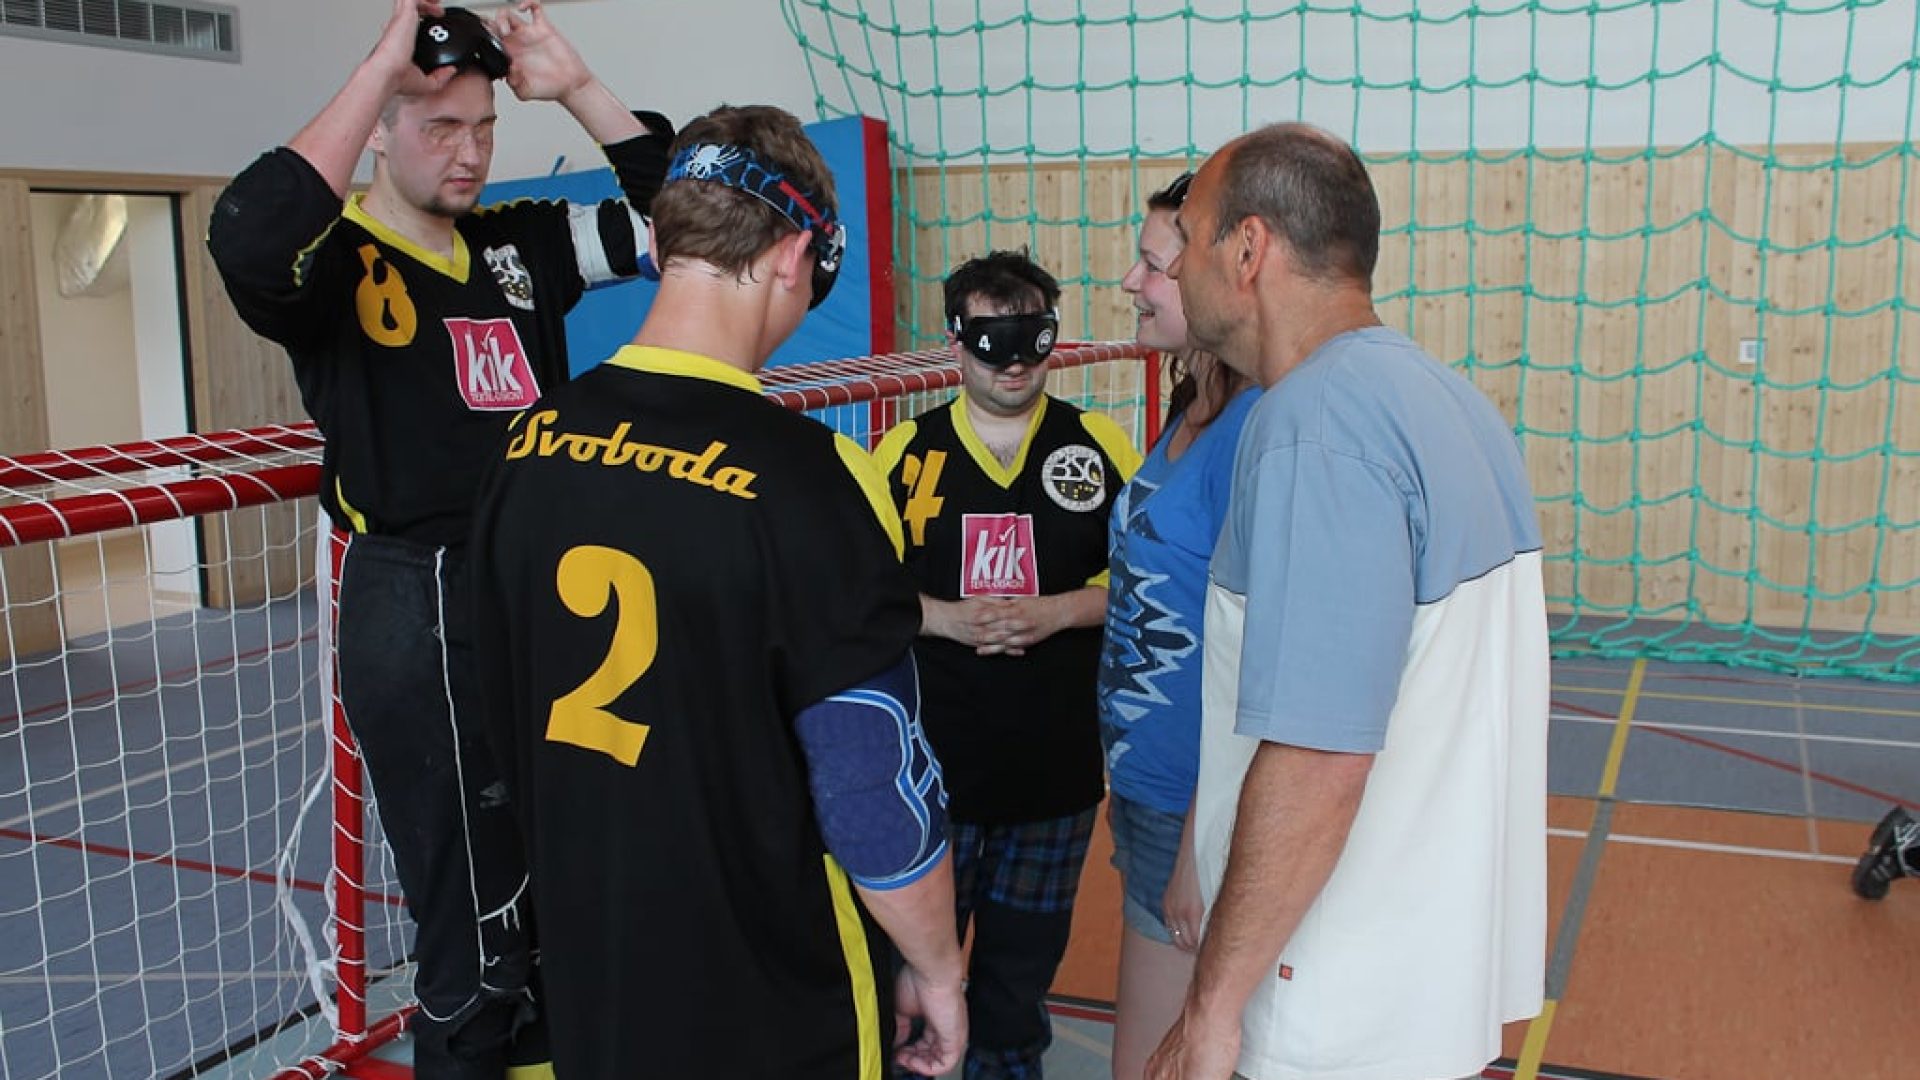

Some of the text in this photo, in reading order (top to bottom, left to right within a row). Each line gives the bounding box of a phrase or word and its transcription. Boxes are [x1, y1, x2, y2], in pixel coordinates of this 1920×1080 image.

[429, 25, 449, 42] 8
[979, 335, 991, 352] 4
[506, 410, 758, 499] Svoboda
[902, 450, 948, 546] 4
[971, 524, 1027, 580] kik
[546, 545, 659, 767] 2
